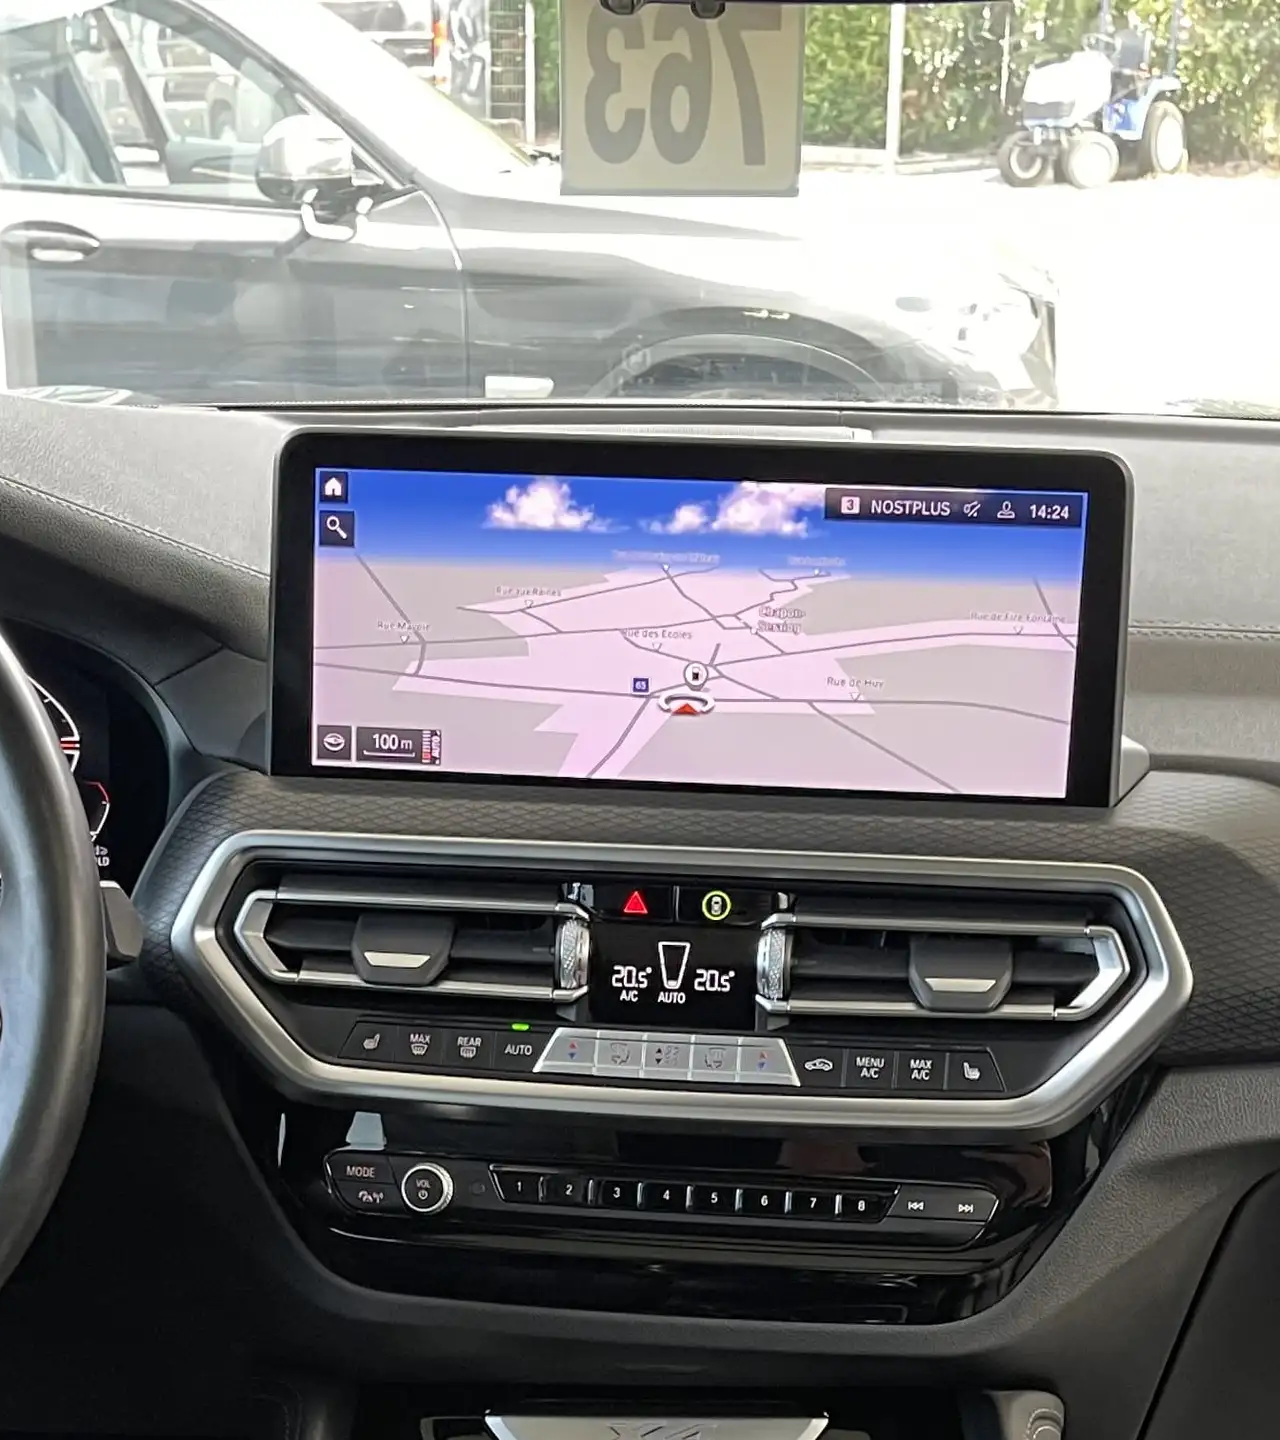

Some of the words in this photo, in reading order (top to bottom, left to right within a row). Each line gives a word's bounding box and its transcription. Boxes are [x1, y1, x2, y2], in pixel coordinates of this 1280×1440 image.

[870, 499, 951, 517] NOSTPLUS
[1029, 503, 1070, 519] 14:24
[372, 733, 399, 750] 100
[400, 740, 413, 750] m
[619, 989, 639, 1002] A/C
[657, 991, 687, 1004] AUTO
[410, 1033, 431, 1044] MAX
[457, 1036, 482, 1048] REAR
[505, 1044, 533, 1057] AUTO
[855, 1056, 885, 1068] MENU
[909, 1059, 933, 1071] MAX
[860, 1067, 880, 1080] A/C
[911, 1069, 931, 1081] A/C
[346, 1164, 376, 1178] MODE
[415, 1178, 431, 1189] VOL
[515, 1180, 522, 1193] 1
[565, 1183, 573, 1196] 2
[612, 1186, 621, 1199] 3
[662, 1189, 670, 1201] 4
[710, 1191, 718, 1204] 5
[760, 1194, 769, 1207] 6
[809, 1197, 817, 1209] 7
[857, 1200, 866, 1212] 8
